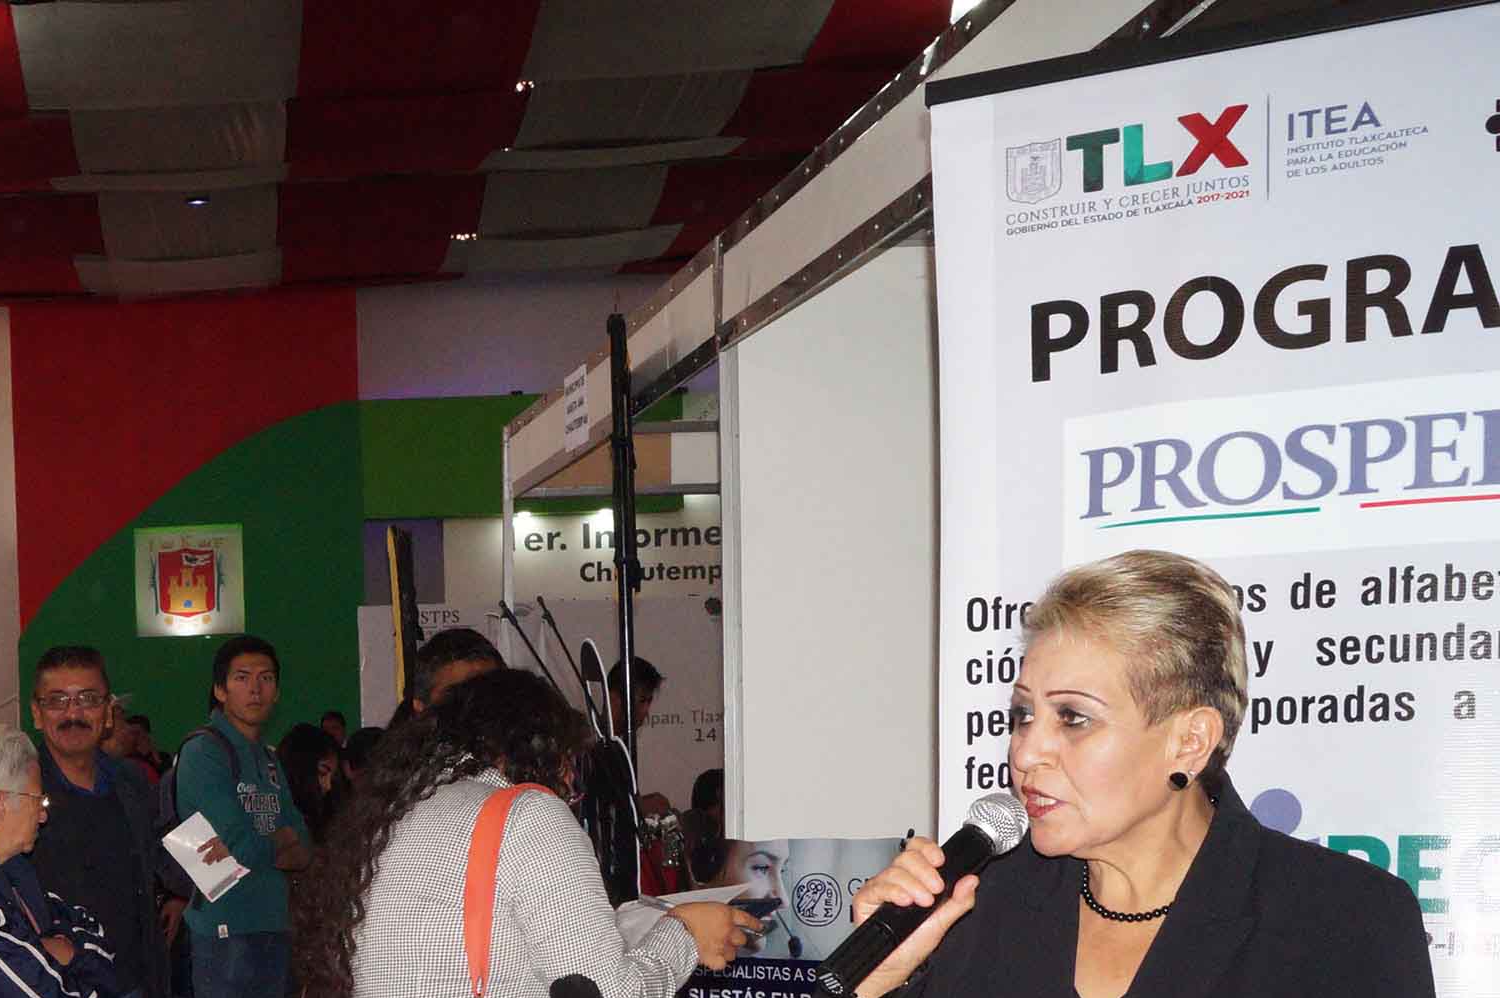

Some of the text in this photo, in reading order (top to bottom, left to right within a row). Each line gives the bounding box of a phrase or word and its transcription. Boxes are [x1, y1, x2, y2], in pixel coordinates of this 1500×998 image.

[1287, 101, 1381, 141] ITEA
[1287, 125, 1429, 156] INSTITUTO TLAXCALTECA
[1066, 104, 1249, 193] TLX
[1287, 140, 1408, 167] PARA LA EDUCACIÓN
[1287, 157, 1384, 178] DE LOS ADULTOS
[1006, 175, 1251, 226] CONSTRUIR Y CRECER JUNTOS
[1006, 190, 1250, 236] GOBIERNO DEL ESTADO DE TLAXCALA 2017-2021
[1030, 243, 1500, 383] PROGRA
[1080, 408, 1500, 520] PROSPE
[583, 523, 722, 549] Inorme
[1290, 572, 1336, 610] de
[1360, 563, 1500, 606] alfabe
[420, 609, 460, 624] STPS
[966, 622, 1500, 685] ció y secunda
[1251, 685, 1415, 734] poradas
[1453, 690, 1476, 720] a
[793, 969, 804, 982] A
